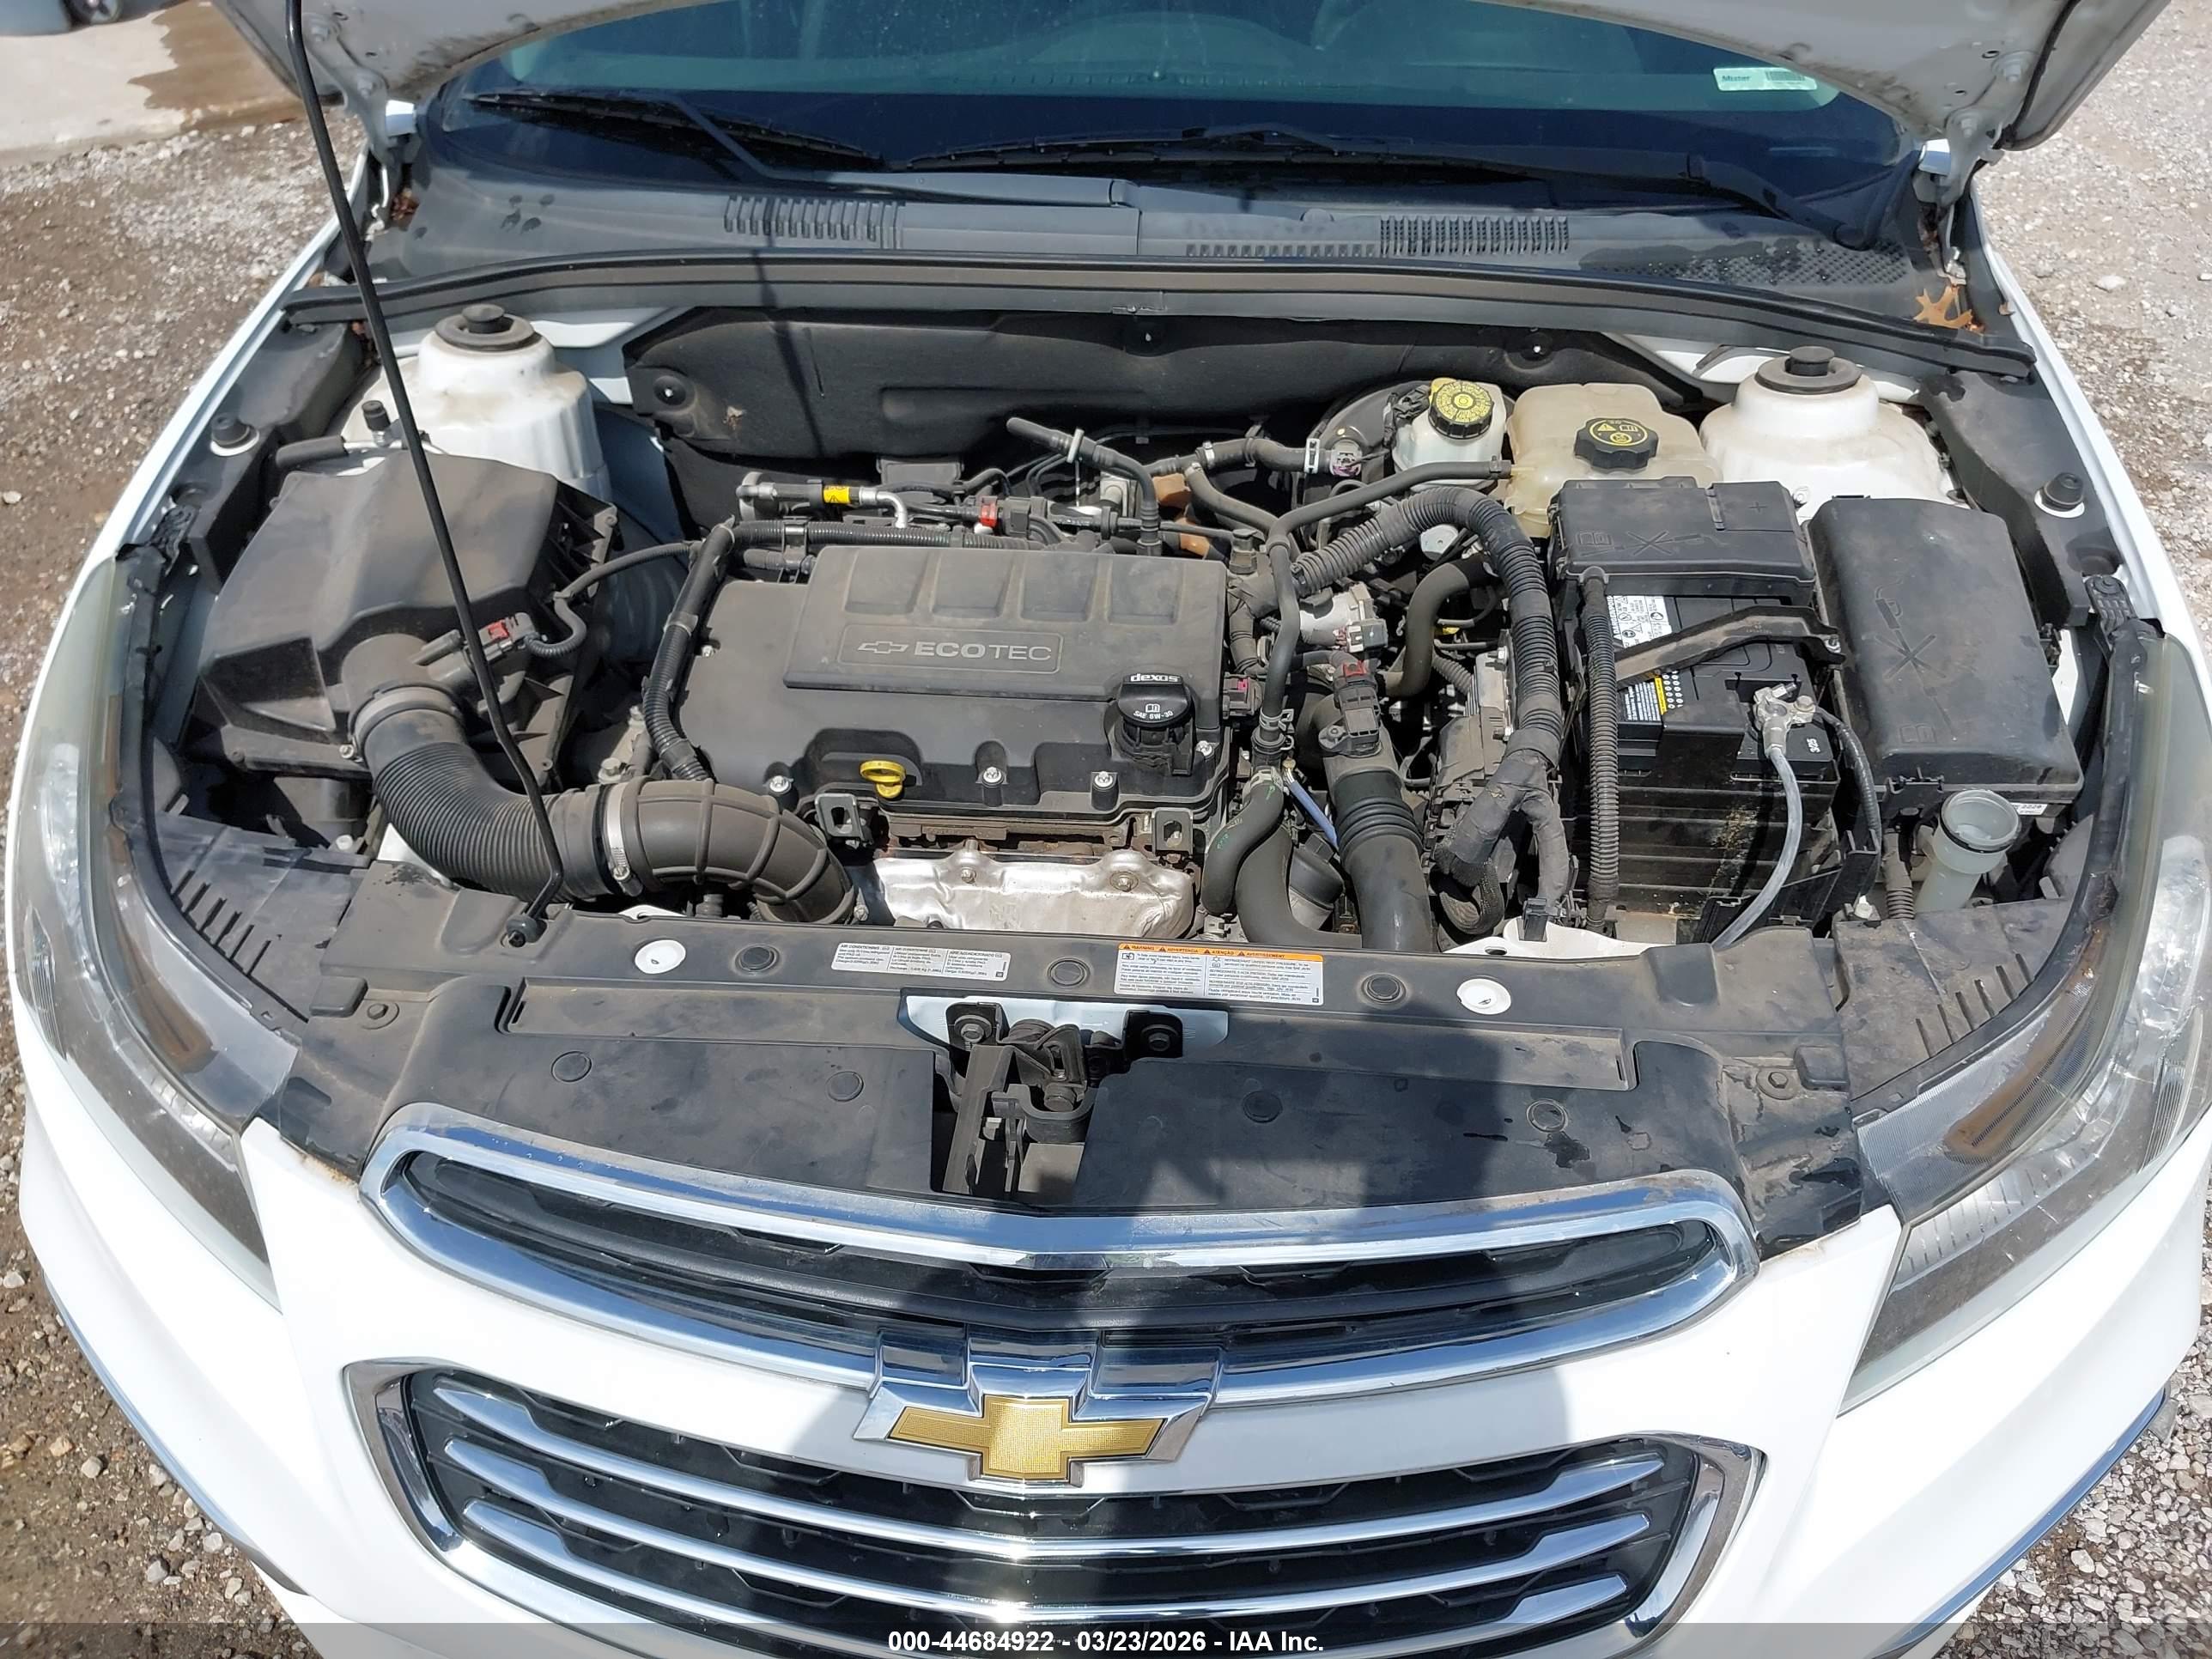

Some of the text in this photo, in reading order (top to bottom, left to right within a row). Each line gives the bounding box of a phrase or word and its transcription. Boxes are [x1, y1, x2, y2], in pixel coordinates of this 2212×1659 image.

[913, 641, 1053, 661] ECOTEC
[1130, 672, 1181, 683] dexos
[1133, 710, 1148, 719] SAE
